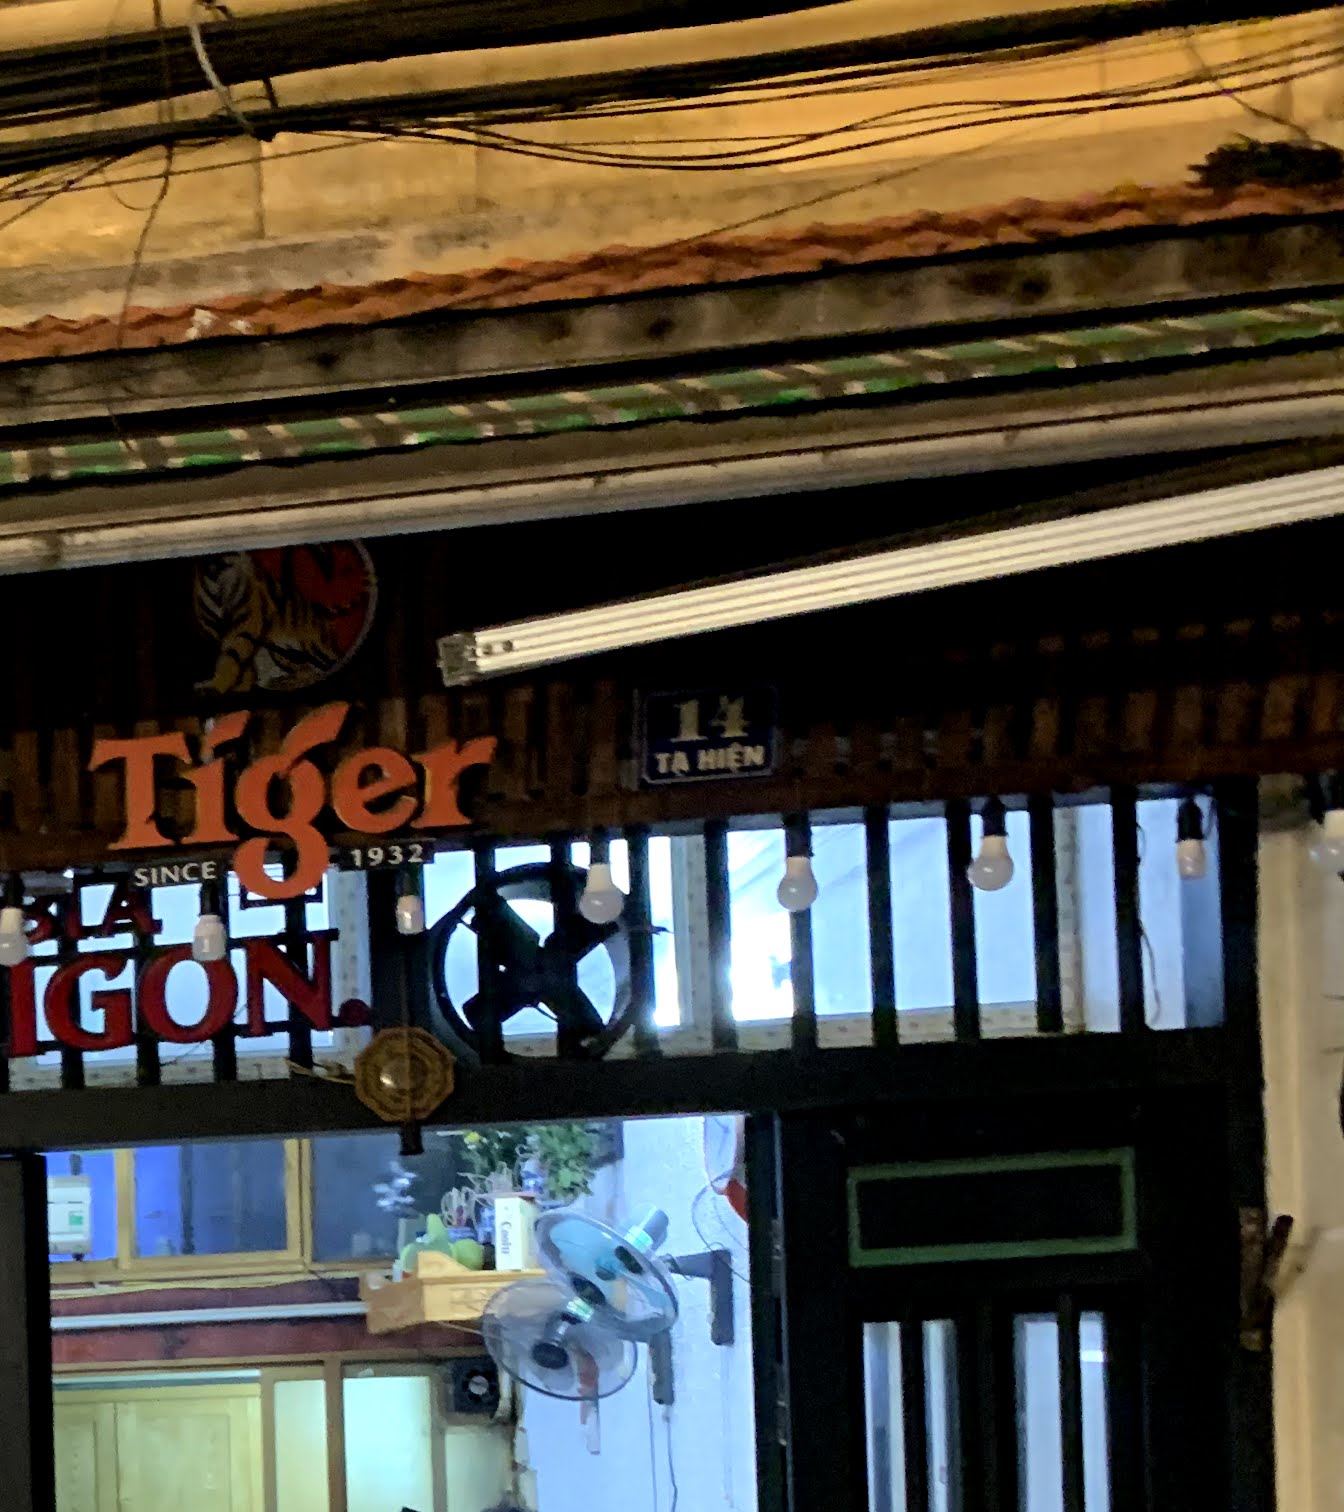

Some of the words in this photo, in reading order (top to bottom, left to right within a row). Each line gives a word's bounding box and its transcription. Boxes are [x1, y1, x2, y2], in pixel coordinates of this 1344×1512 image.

[670, 696, 751, 742] 14
[87, 701, 498, 899] Tiger
[134, 861, 218, 887] SINCE
[351, 843, 423, 867] 1932
